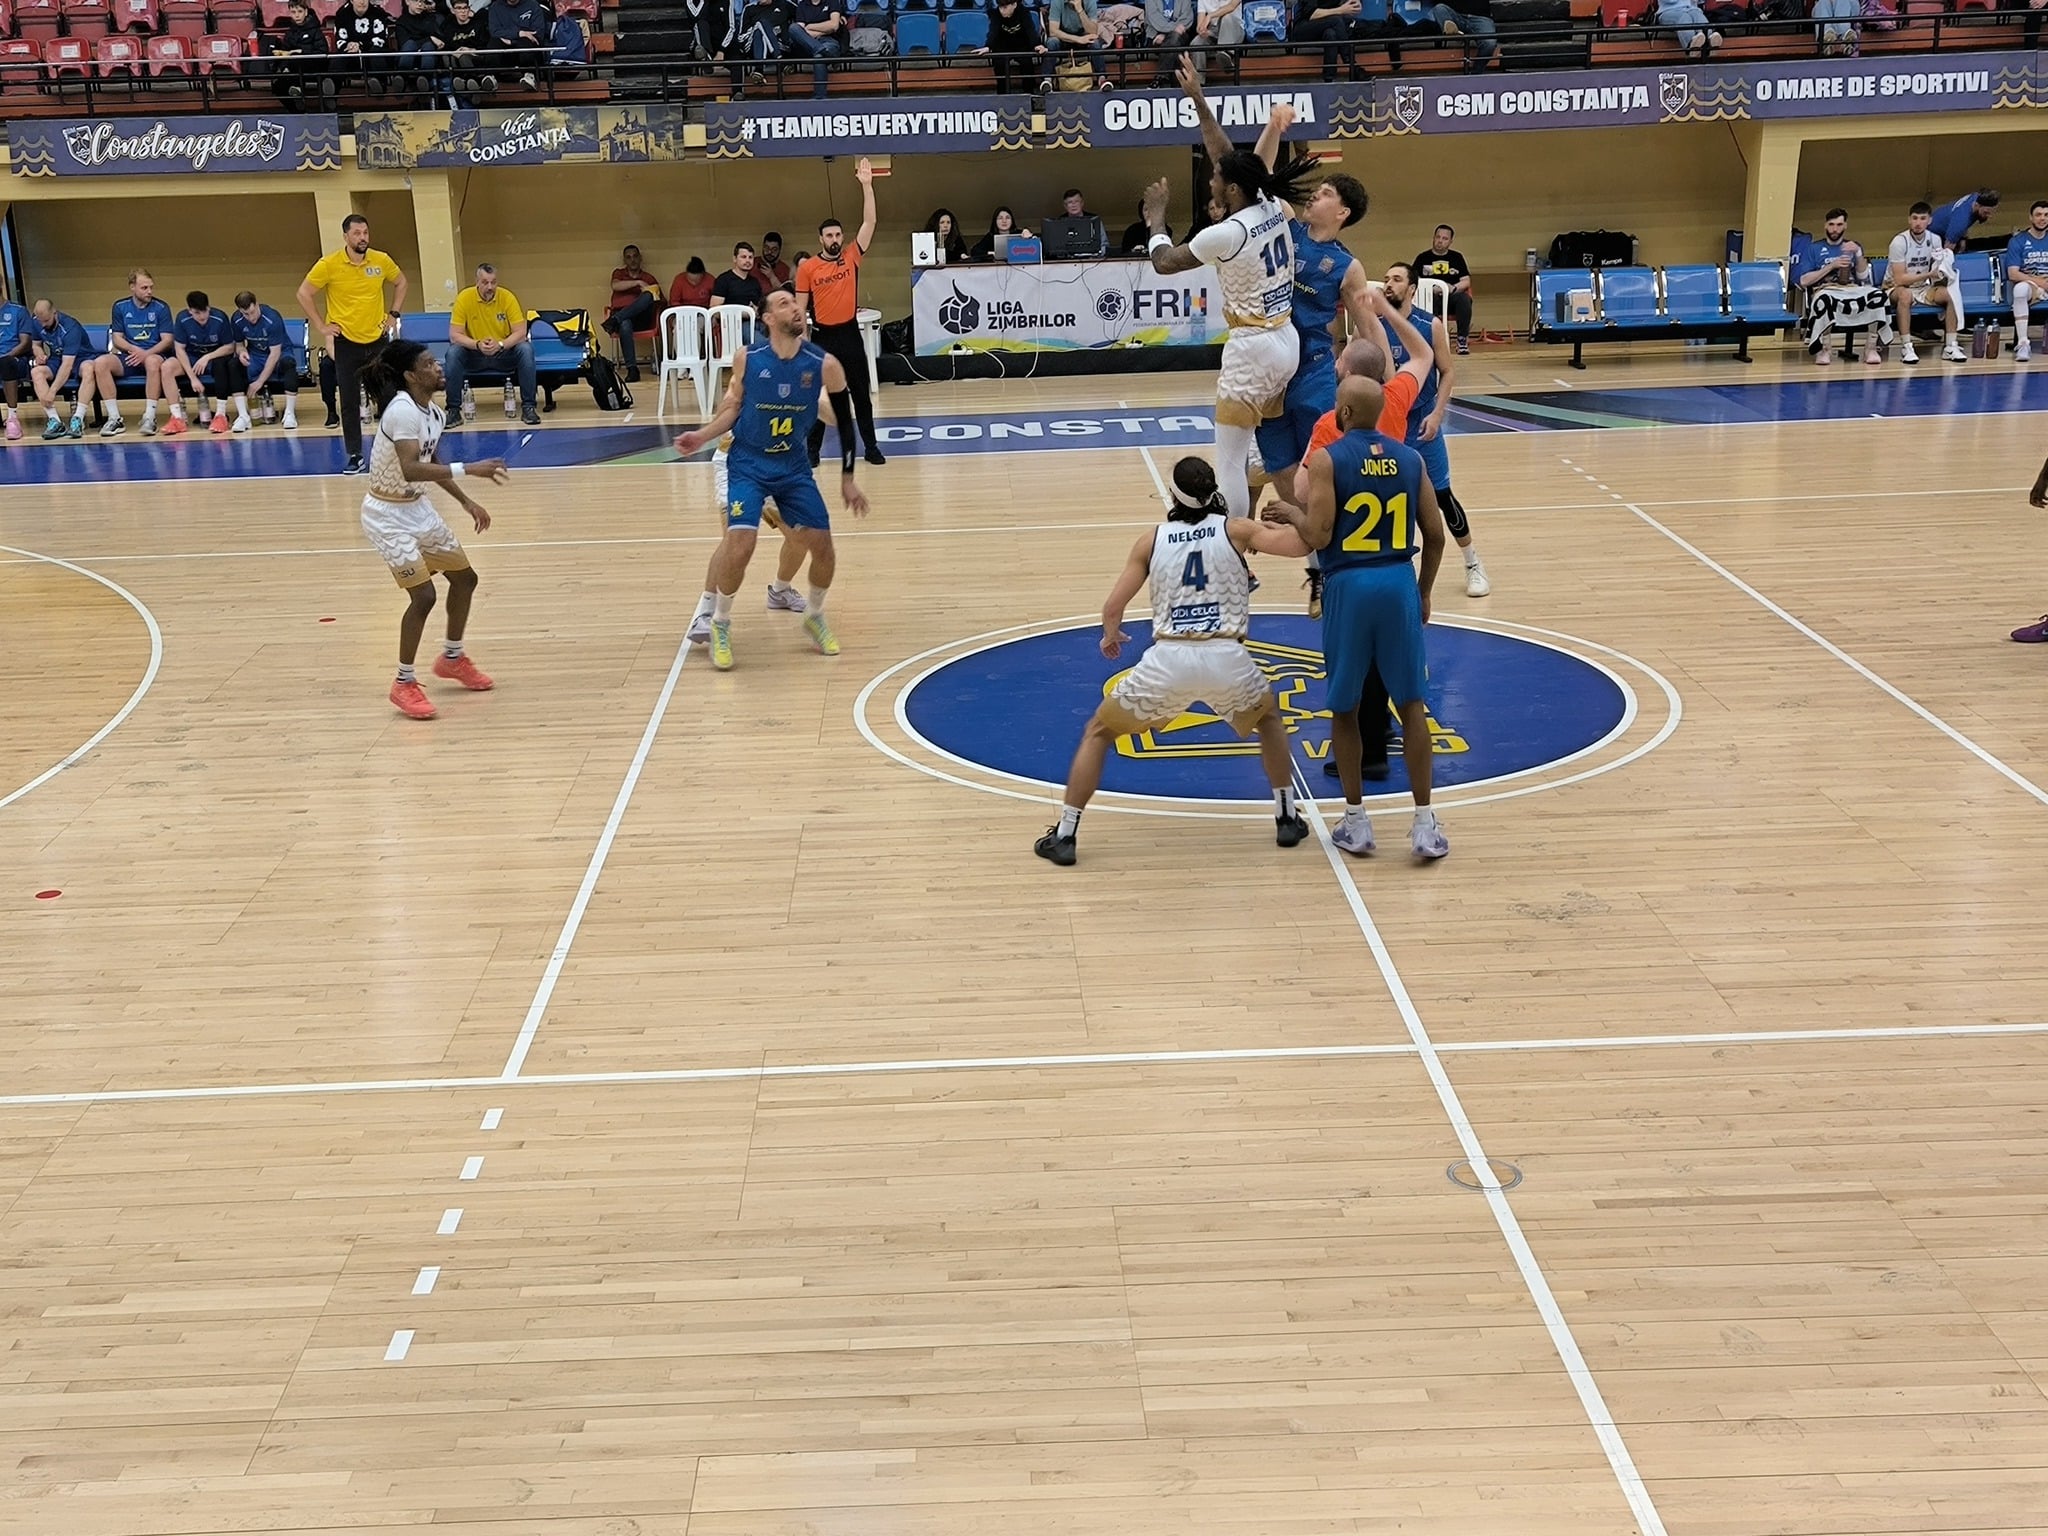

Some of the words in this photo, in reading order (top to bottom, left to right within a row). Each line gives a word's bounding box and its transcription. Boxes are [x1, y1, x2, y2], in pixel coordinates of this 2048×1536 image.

[1756, 80, 1772, 100] O
[1776, 77, 1842, 100] MARE
[1847, 76, 1875, 97] DE
[1880, 71, 1989, 94] SPORTIVI
[1437, 93, 1495, 117] CSM
[1500, 86, 1650, 113] CONSTANȚA
[501, 112, 537, 137] Visit
[741, 111, 998, 142] #TEAMISEVERYTHING
[90, 121, 260, 169] Constangeles
[987, 301, 1024, 315] LIGA
[1133, 288, 1207, 320] FRH
[988, 313, 1076, 330] ZIMBRILOR
[769, 417, 793, 437] 14
[875, 416, 1215, 442] CONSTA
[1361, 458, 1398, 476] JONES
[1342, 491, 1408, 551] 21
[1167, 527, 1216, 544] NELSON
[1182, 550, 1208, 592] 4
